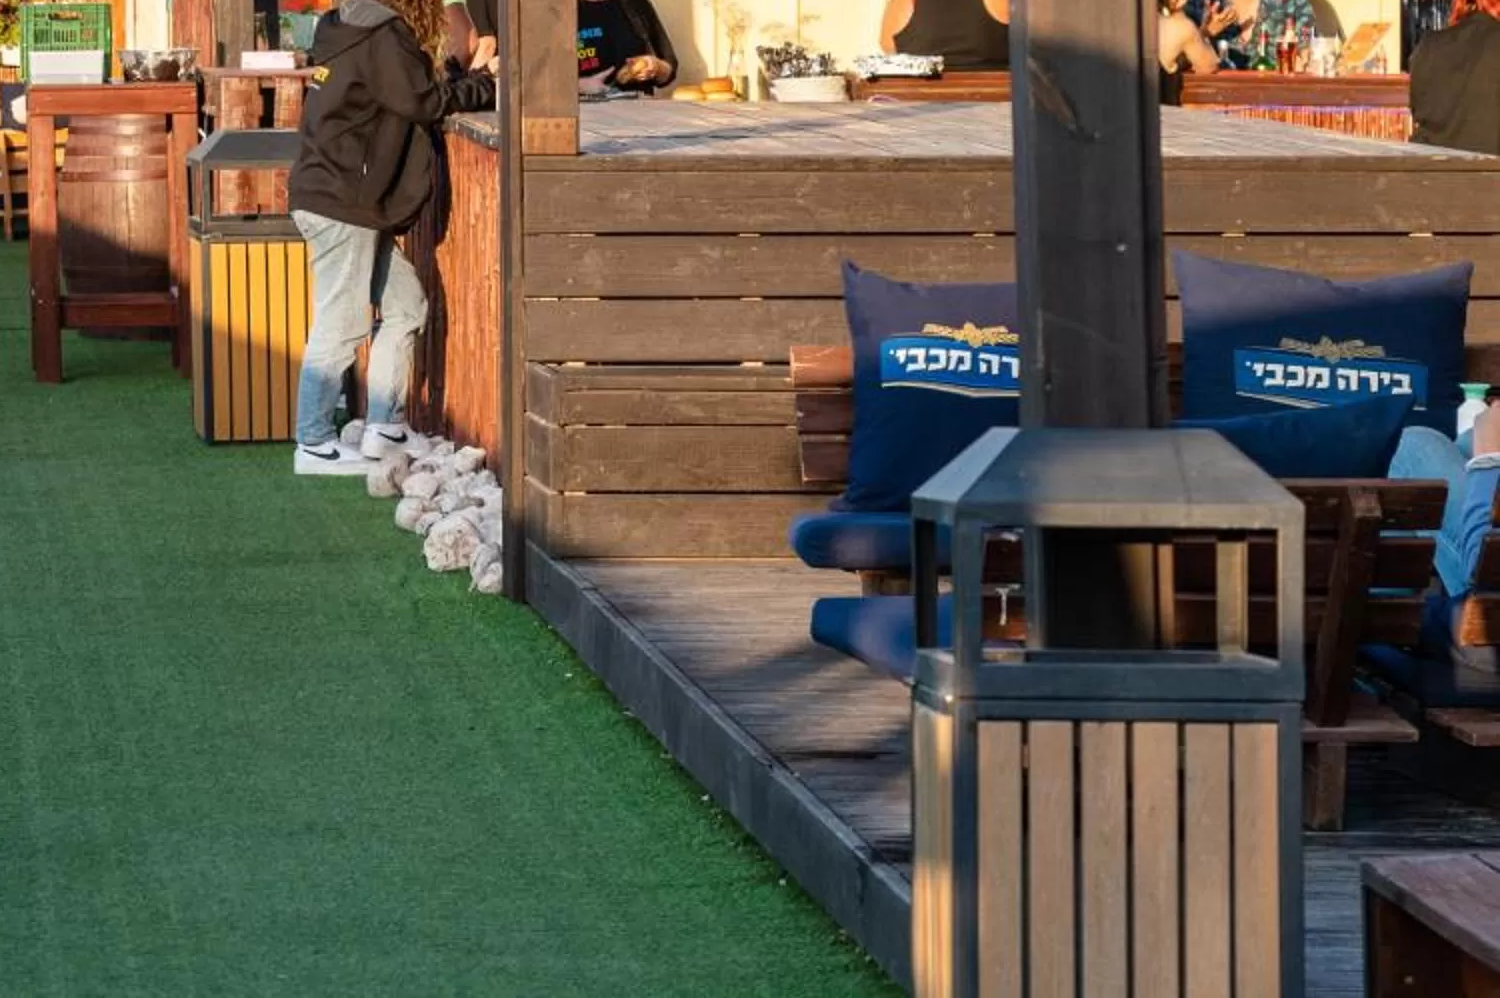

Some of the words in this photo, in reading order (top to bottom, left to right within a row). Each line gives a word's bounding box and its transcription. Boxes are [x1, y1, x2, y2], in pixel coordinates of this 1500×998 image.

[888, 347, 972, 373] מכבי
[977, 352, 1020, 379] רה
[1246, 361, 1331, 389] מכבי
[1335, 367, 1413, 395] בירה
